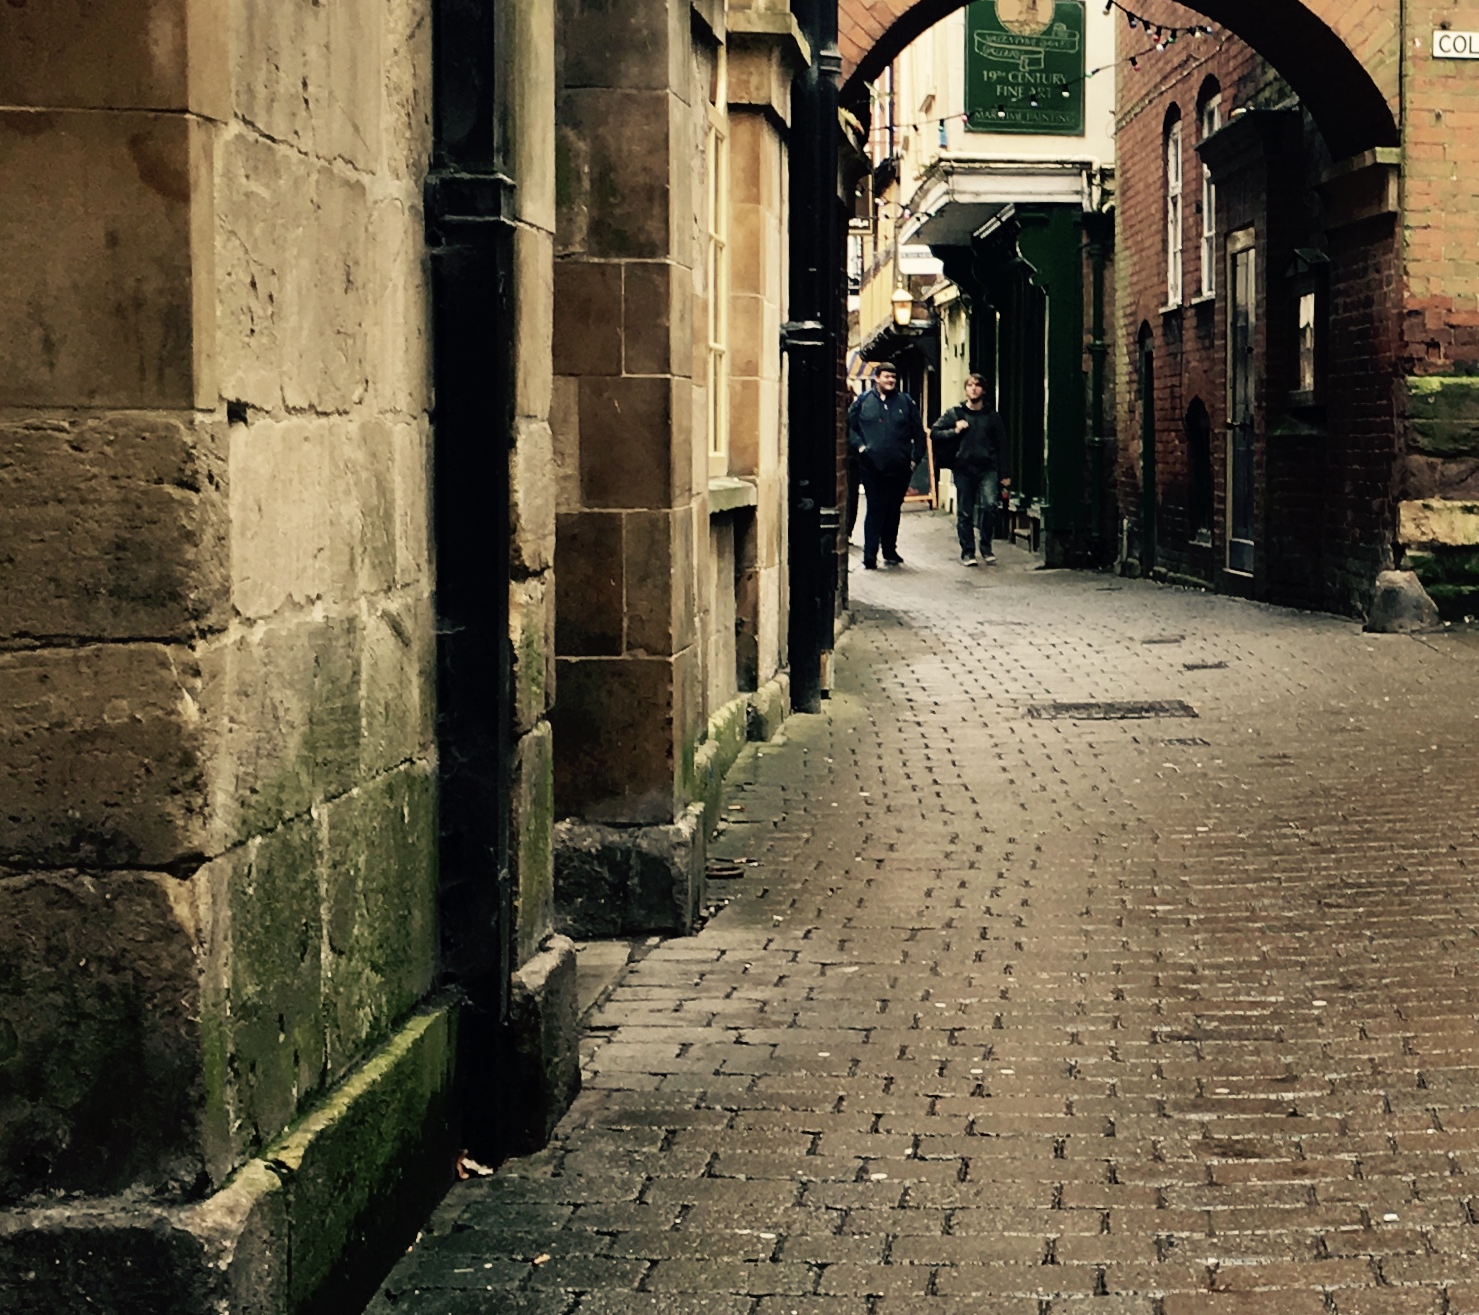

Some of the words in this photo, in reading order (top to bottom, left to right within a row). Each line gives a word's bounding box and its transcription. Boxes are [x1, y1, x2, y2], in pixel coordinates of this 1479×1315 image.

[1008, 72, 1067, 84] CENTURY
[996, 84, 1025, 97] FINE
[1028, 87, 1052, 99] ART
[974, 110, 1022, 121] MARIME
